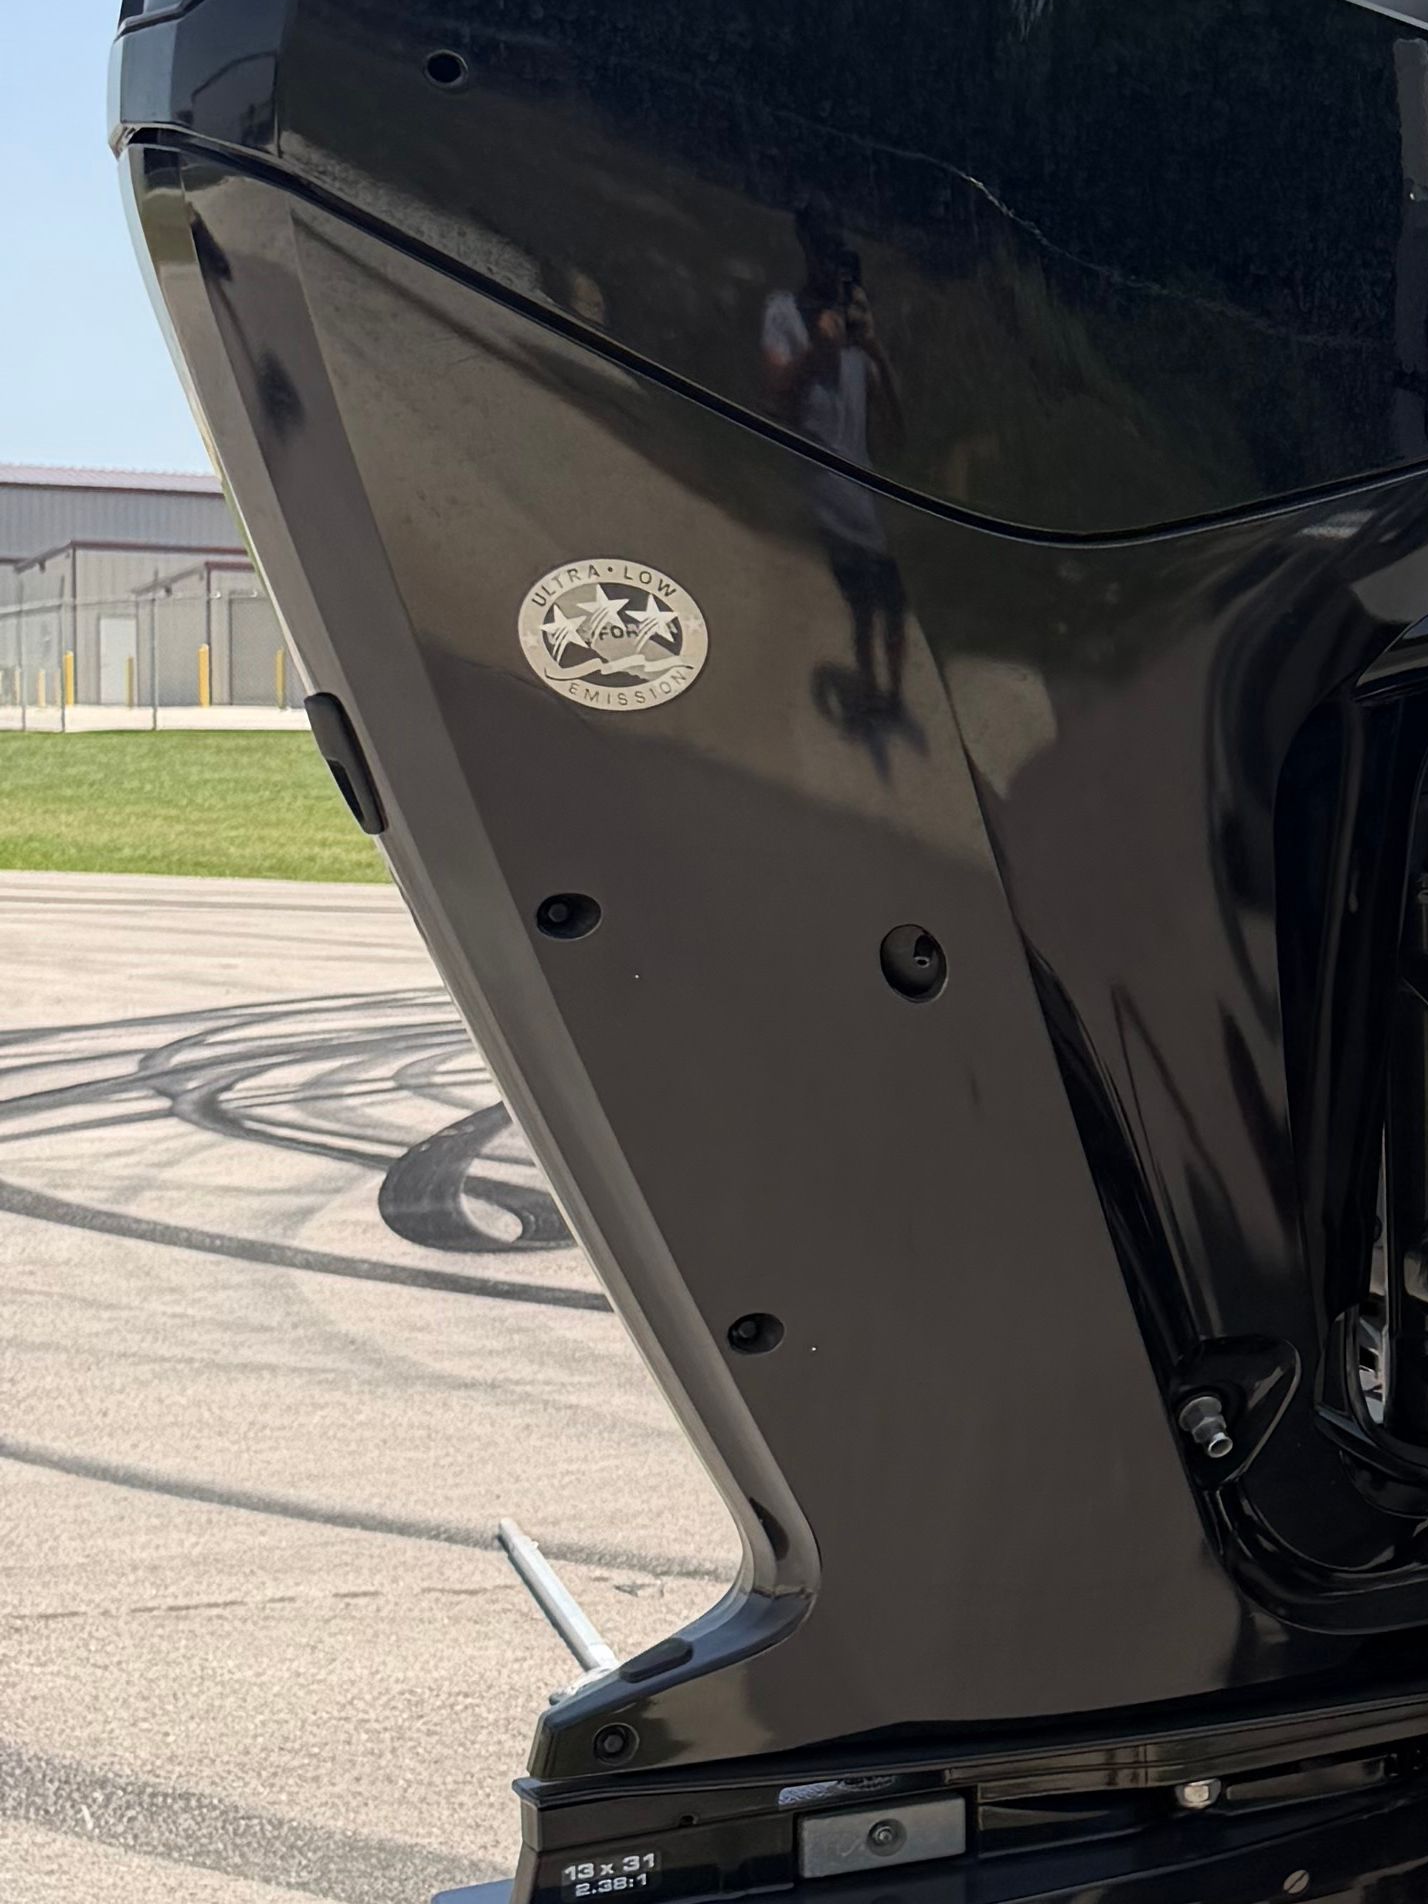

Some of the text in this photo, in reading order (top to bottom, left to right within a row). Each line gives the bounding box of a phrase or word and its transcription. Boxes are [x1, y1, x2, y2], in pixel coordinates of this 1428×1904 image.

[531, 564, 677, 608] ULTRA LOW
[568, 669, 688, 707] EMISSION
[564, 1862, 595, 1881] 13
[622, 1852, 655, 1872] 31
[575, 1873, 647, 1897] 2.38:1
